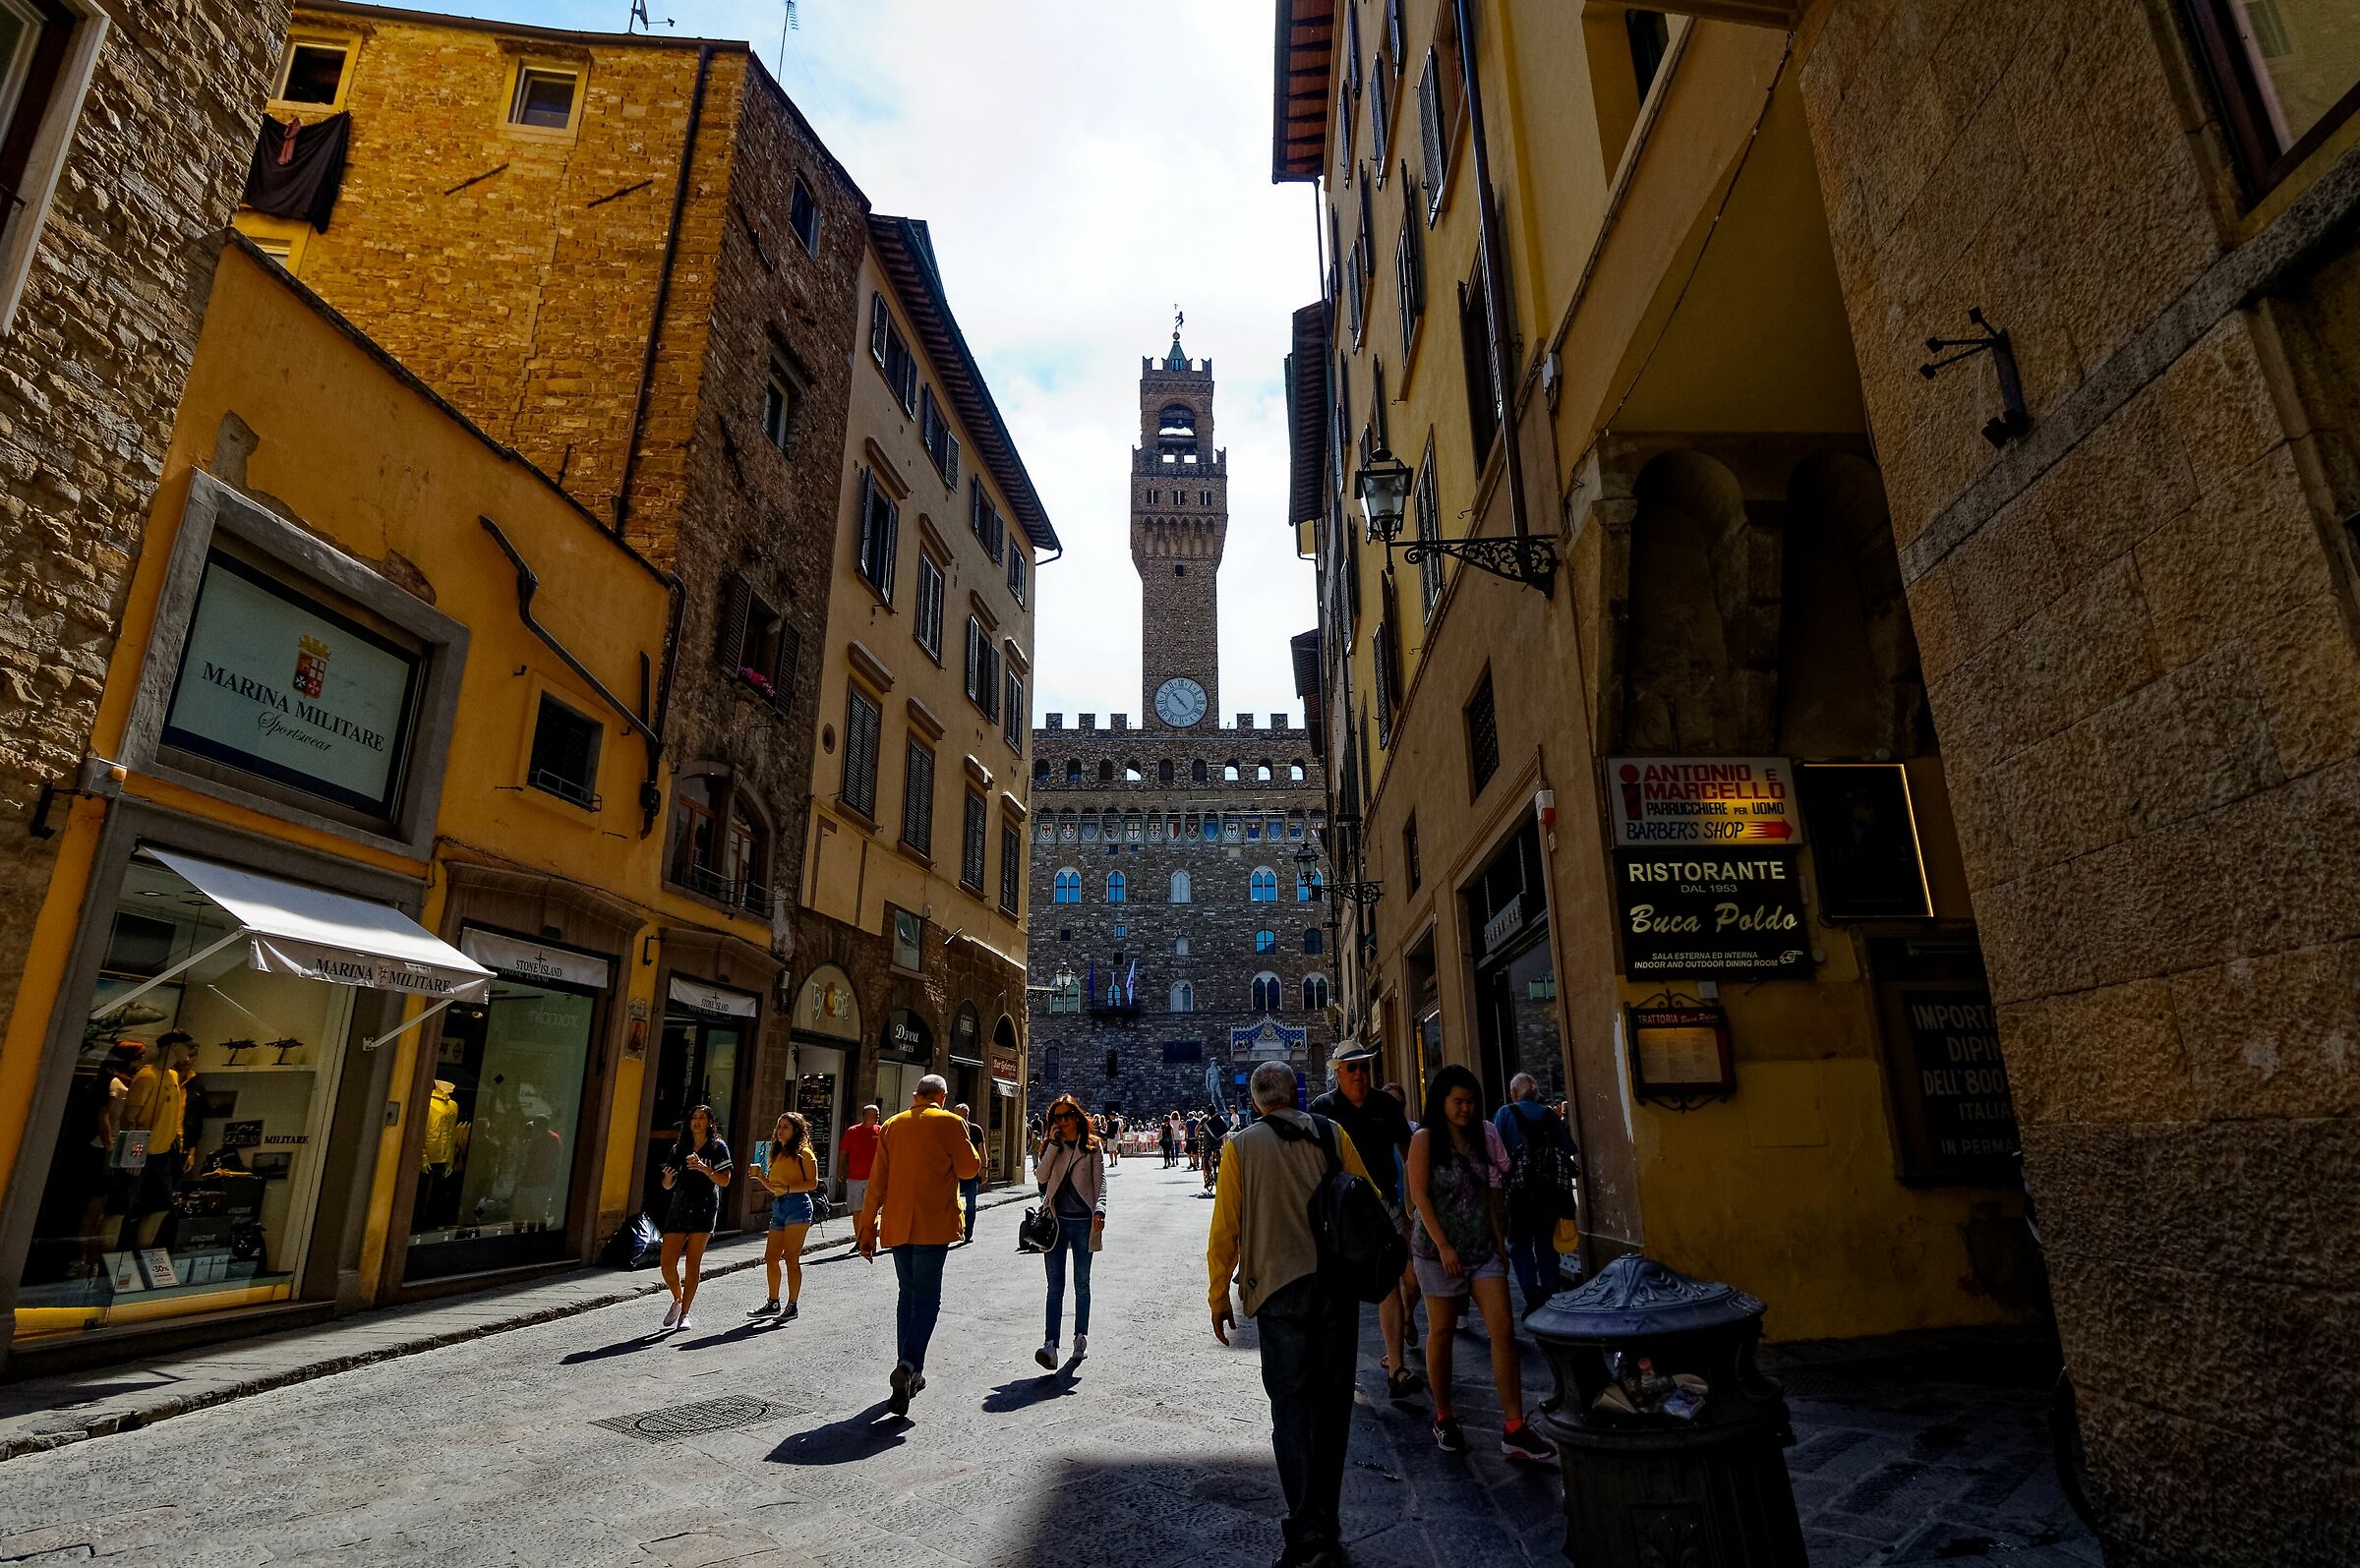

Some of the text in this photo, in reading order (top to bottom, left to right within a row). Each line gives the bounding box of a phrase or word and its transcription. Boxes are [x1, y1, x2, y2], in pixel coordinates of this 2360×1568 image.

[202, 661, 384, 751] MARINA MILITARE
[258, 711, 332, 751] Sportswear
[1644, 764, 1777, 783] ANTONIO E
[1644, 783, 1786, 800] MARCELLO
[1647, 802, 1728, 816] PARRUCCHIERE
[1752, 802, 1785, 815] UOMO
[1626, 822, 1744, 841] BARBER'S SHOP
[1628, 861, 1786, 882] RISTORANTE
[1681, 885, 1706, 894] DAL
[1629, 902, 1798, 933] Buca Poldo
[315, 958, 452, 994] MARINA MILITARE
[515, 959, 562, 977] STONE ISLAND
[1637, 1014, 1679, 1024] TRATTORIA
[264, 1135, 309, 1144] MILITARE
[1940, 1140, 1957, 1155] IN
